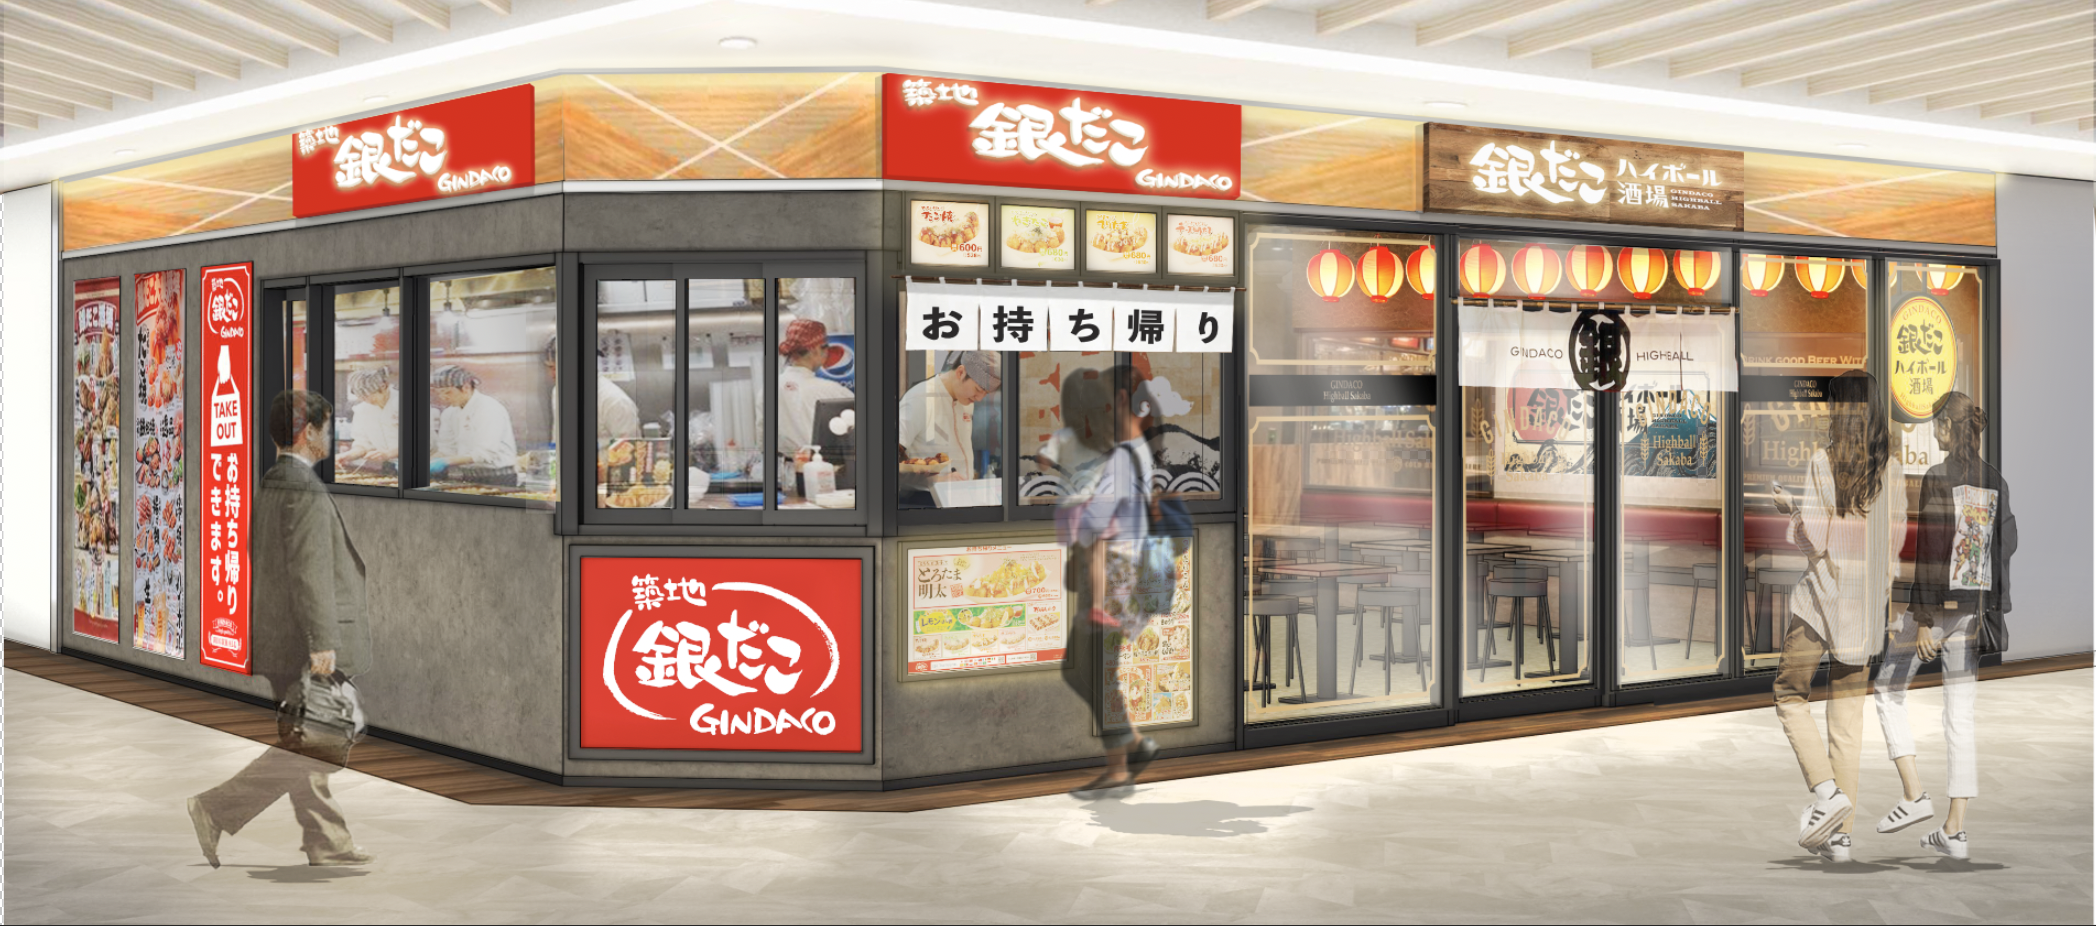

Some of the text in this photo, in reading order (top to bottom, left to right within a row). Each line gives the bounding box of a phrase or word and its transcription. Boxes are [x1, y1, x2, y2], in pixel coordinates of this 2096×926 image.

[902, 79, 979, 106] 築地
[298, 125, 340, 155] 築地
[969, 97, 1148, 167] 銀だこ
[334, 115, 447, 189] 銀だこ
[437, 165, 513, 193] GINDACO
[1135, 168, 1233, 192] GINDACO
[1468, 140, 1608, 204] 銀だこ
[1616, 158, 1723, 187] ハイボール
[1617, 181, 1670, 209] 酒場
[1670, 189, 1714, 198] GINDACO
[212, 288, 239, 323] 銀だこ
[1902, 304, 1942, 324] GINDACO
[922, 306, 1219, 345] お持ち帰り
[1896, 318, 1943, 355] 銀だこ
[1510, 346, 1563, 360] GINDACO
[1895, 358, 1947, 374] ハイボール
[1323, 391, 1371, 402] Highball Sakaba
[1330, 380, 1363, 389] GINDACO
[1909, 377, 1934, 395] 酒場
[214, 400, 238, 419] TAKE
[1636, 390, 1711, 427] GINDACO
[216, 422, 237, 440] OUT
[1480, 406, 1572, 444] GINDACO
[1653, 434, 1696, 453] Highball
[1656, 452, 1692, 467] Sakaba
[210, 453, 223, 602] できます。
[225, 452, 241, 615] お持ち帰り
[631, 574, 708, 611] 築地
[631, 609, 804, 696] 銀だこ
[689, 703, 836, 735] GINDACO
